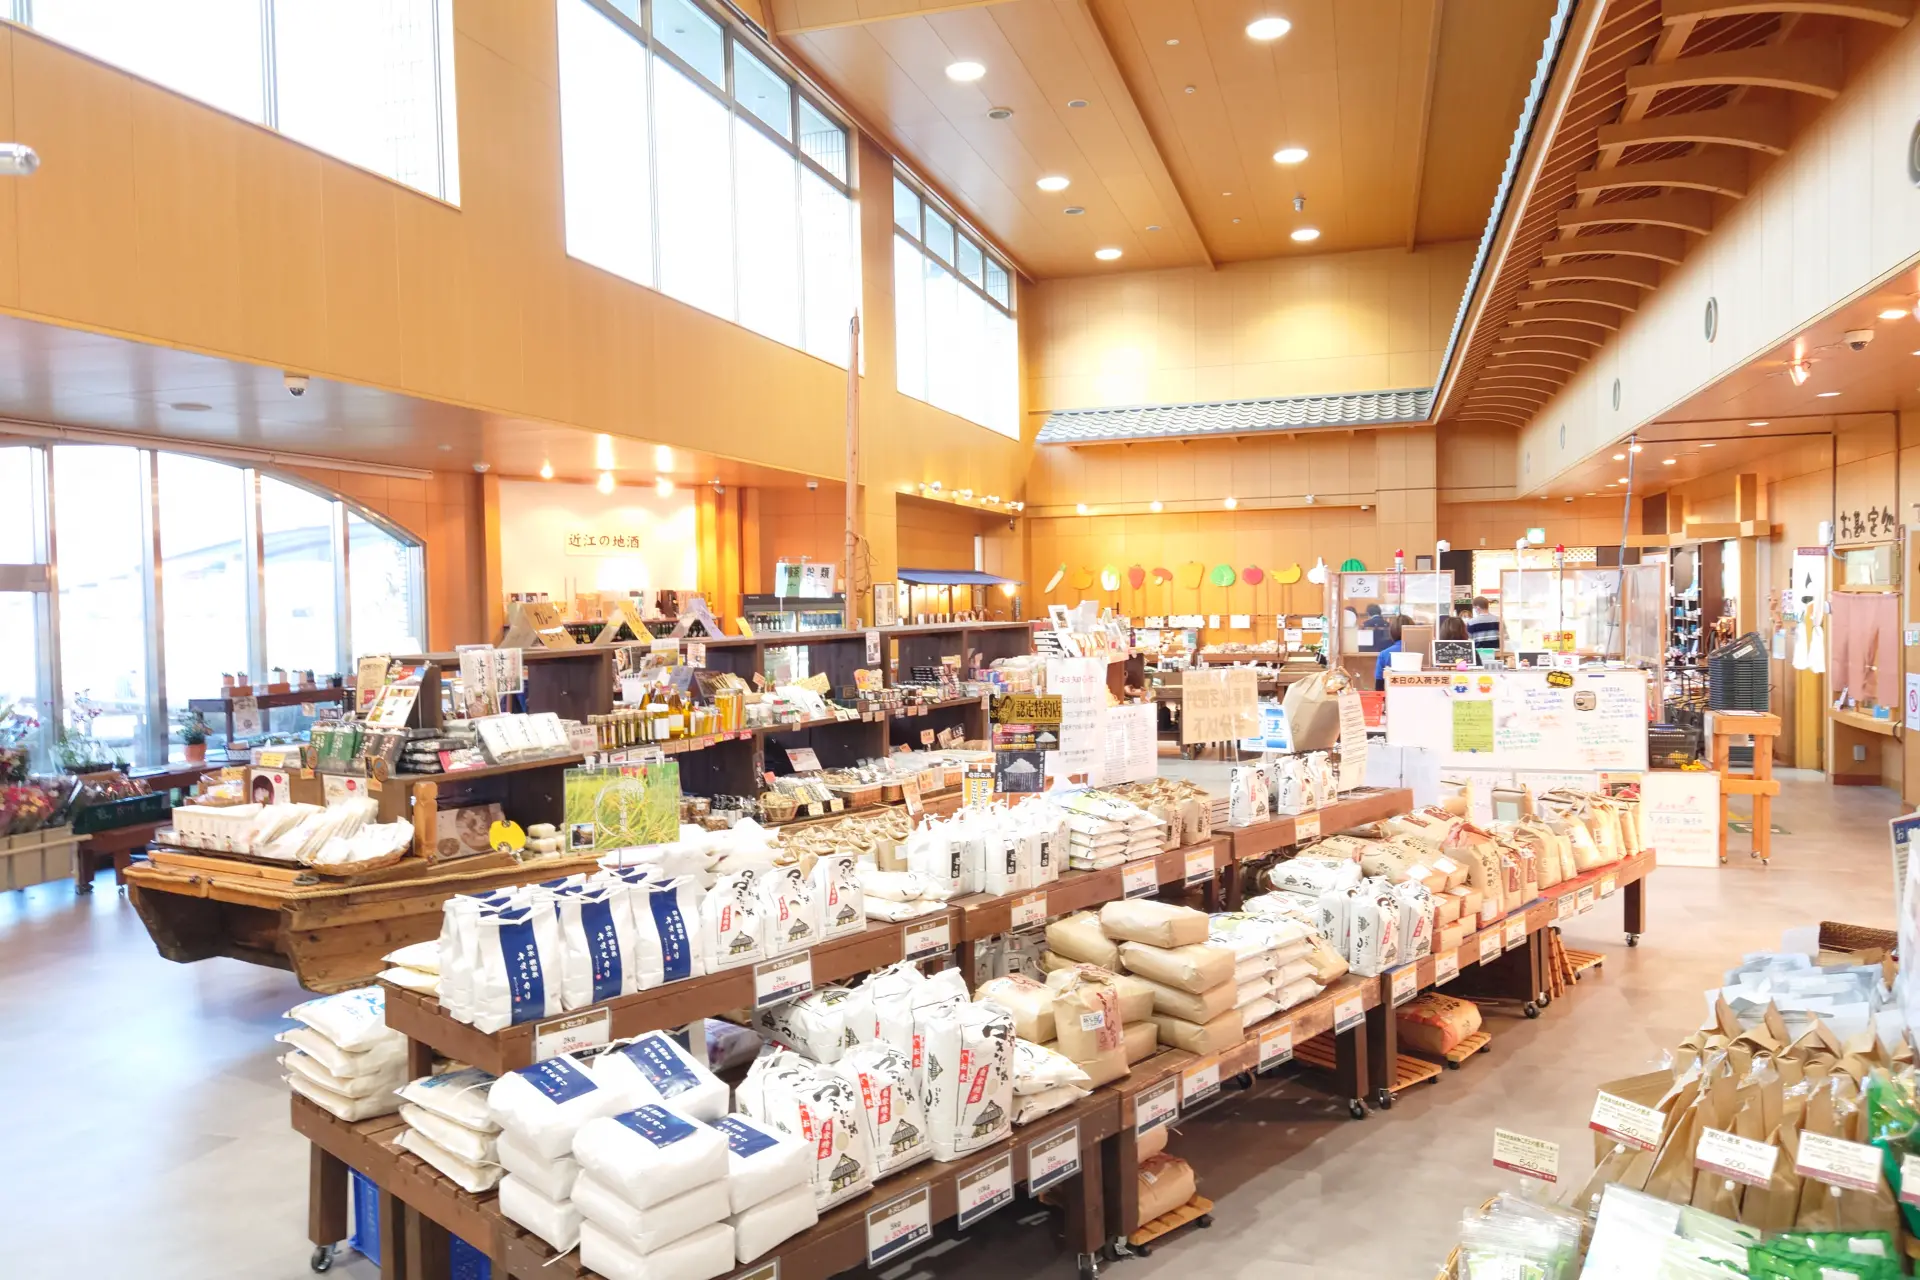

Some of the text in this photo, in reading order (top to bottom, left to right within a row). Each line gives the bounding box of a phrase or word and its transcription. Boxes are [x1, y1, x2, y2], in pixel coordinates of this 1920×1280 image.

[568, 533, 640, 548] 近江の地酒
[1356, 577, 1366, 585] ②
[1390, 676, 1450, 685] 本日の入荷予定
[1016, 700, 1061, 718] 認定特約店
[775, 975, 786, 983] 2kg
[563, 1035, 577, 1045] 2kg
[970, 1068, 987, 1101] 自家精米
[880, 1090, 888, 1122] 自家精米
[1618, 1123, 1639, 1136] 540
[820, 1123, 830, 1157] 自家精米
[1519, 1158, 1538, 1170] 540
[1724, 1157, 1745, 1170] 500
[1826, 1163, 1851, 1174] 420
